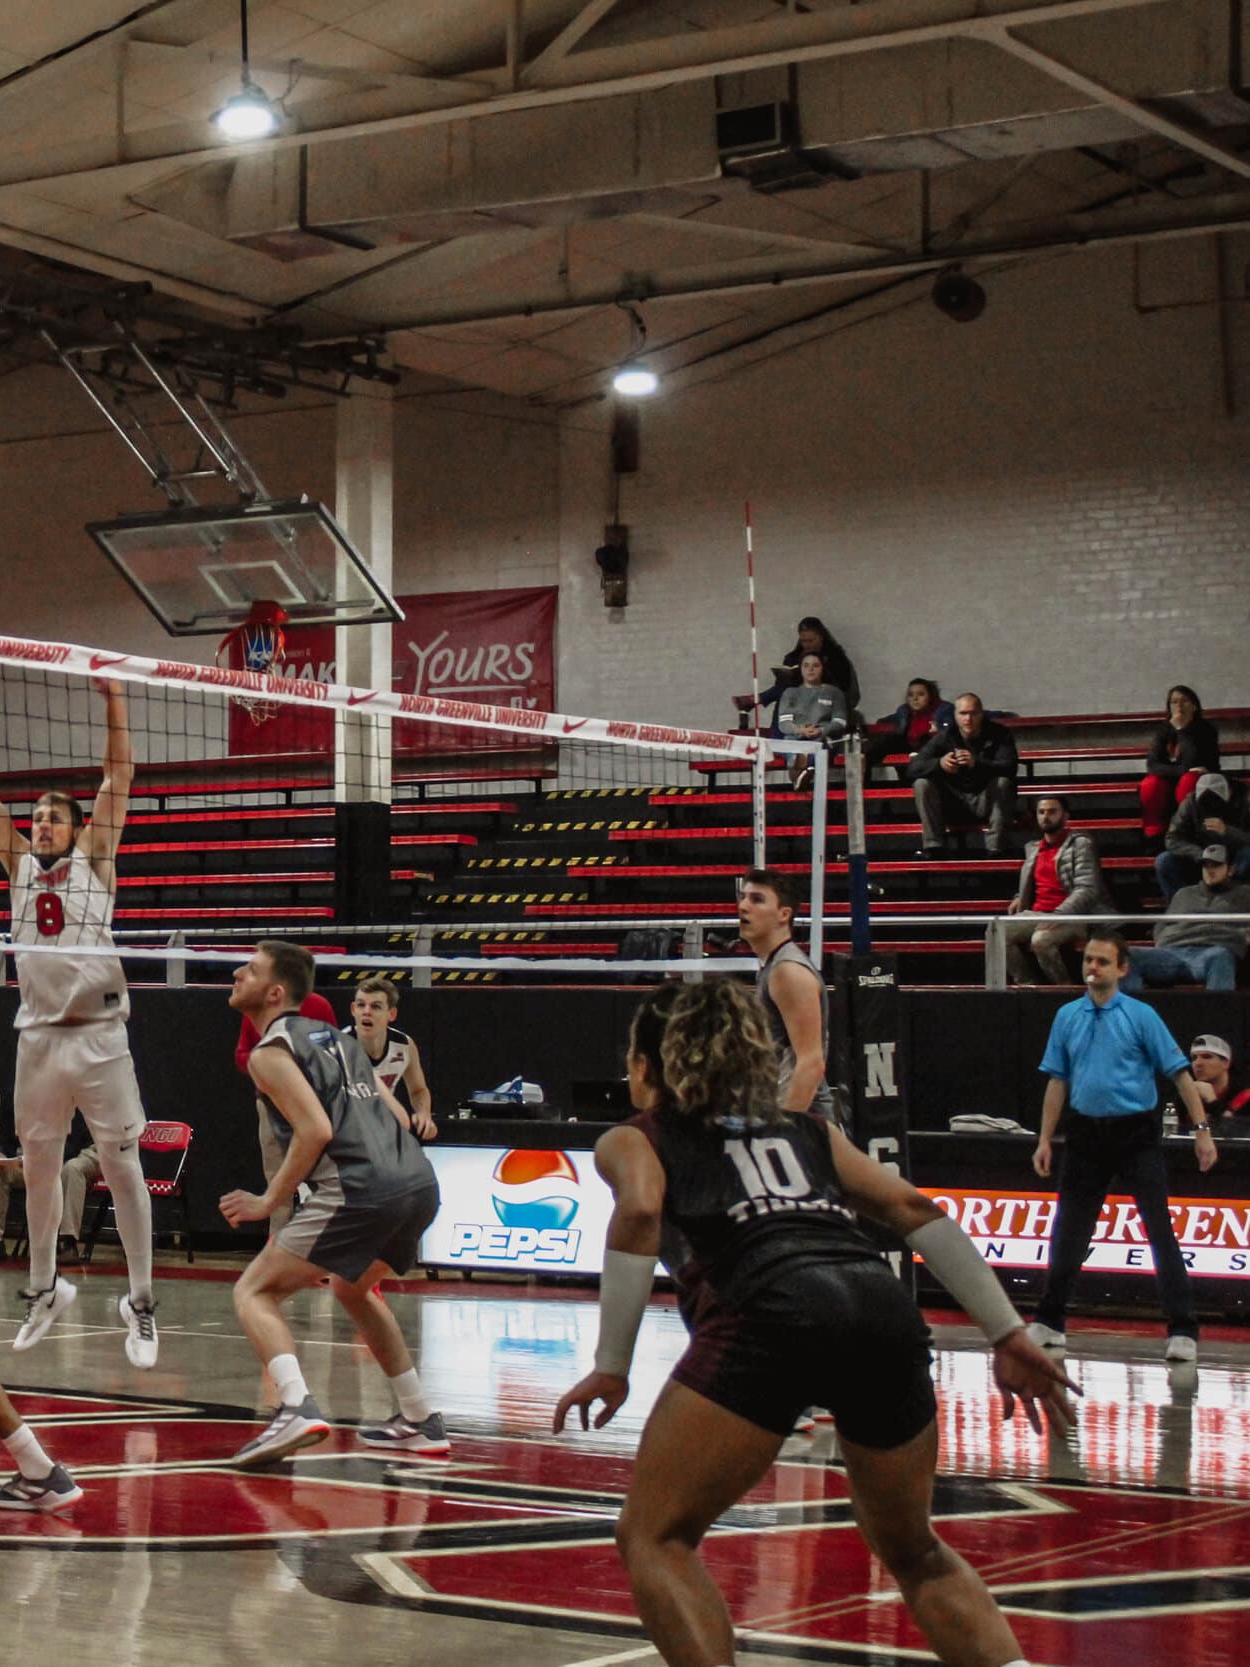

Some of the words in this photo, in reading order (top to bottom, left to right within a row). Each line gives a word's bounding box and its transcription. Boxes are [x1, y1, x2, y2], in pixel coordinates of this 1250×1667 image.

[267, 674, 329, 701] UNIVERSITY
[273, 661, 336, 684] MAK
[399, 695, 435, 714] NORTH
[436, 701, 493, 723] GREENVILLE
[494, 708, 548, 730] UNIVERSITY
[36, 892, 65, 937] 8
[724, 1137, 811, 1199] 10
[450, 1223, 581, 1264] PEPSI
